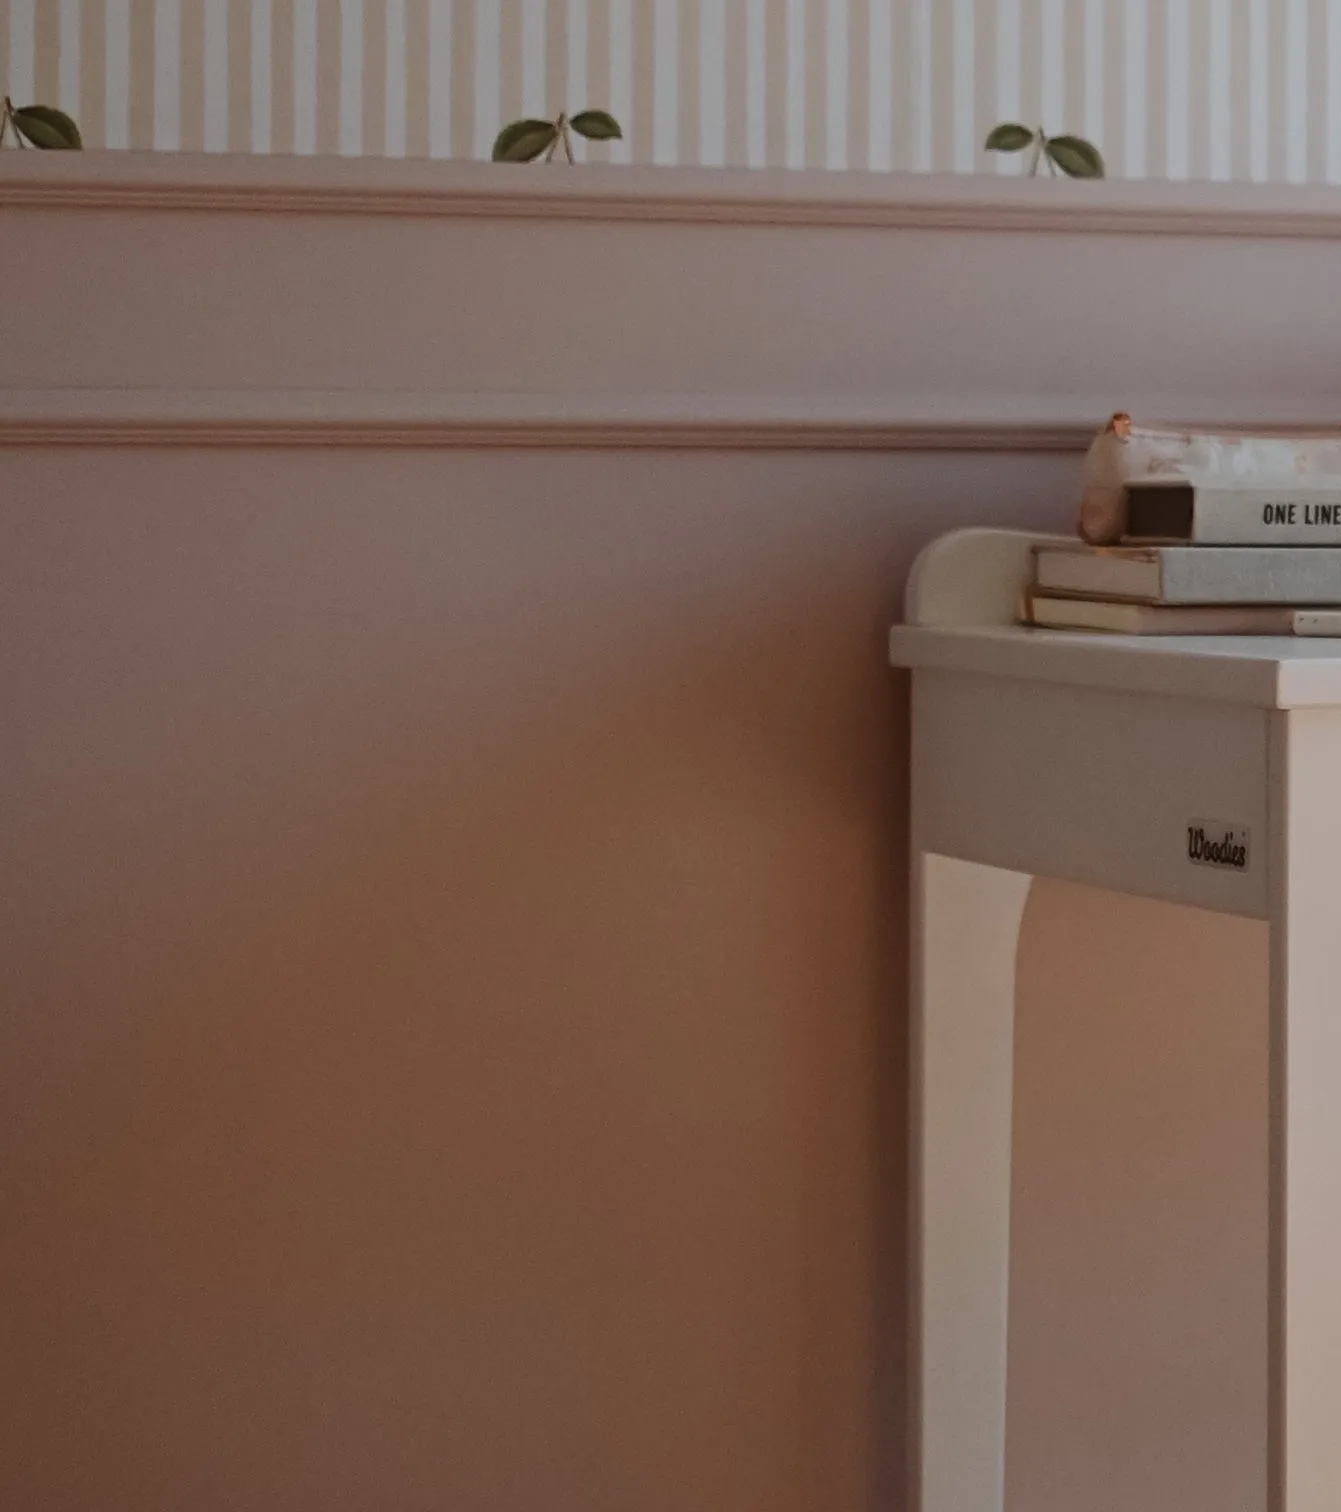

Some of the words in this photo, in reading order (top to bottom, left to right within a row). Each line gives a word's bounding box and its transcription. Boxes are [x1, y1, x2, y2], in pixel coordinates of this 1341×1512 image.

[1263, 504, 1297, 525] ONE
[1304, 504, 1341, 525] LINE
[1188, 827, 1246, 867] Woodies
